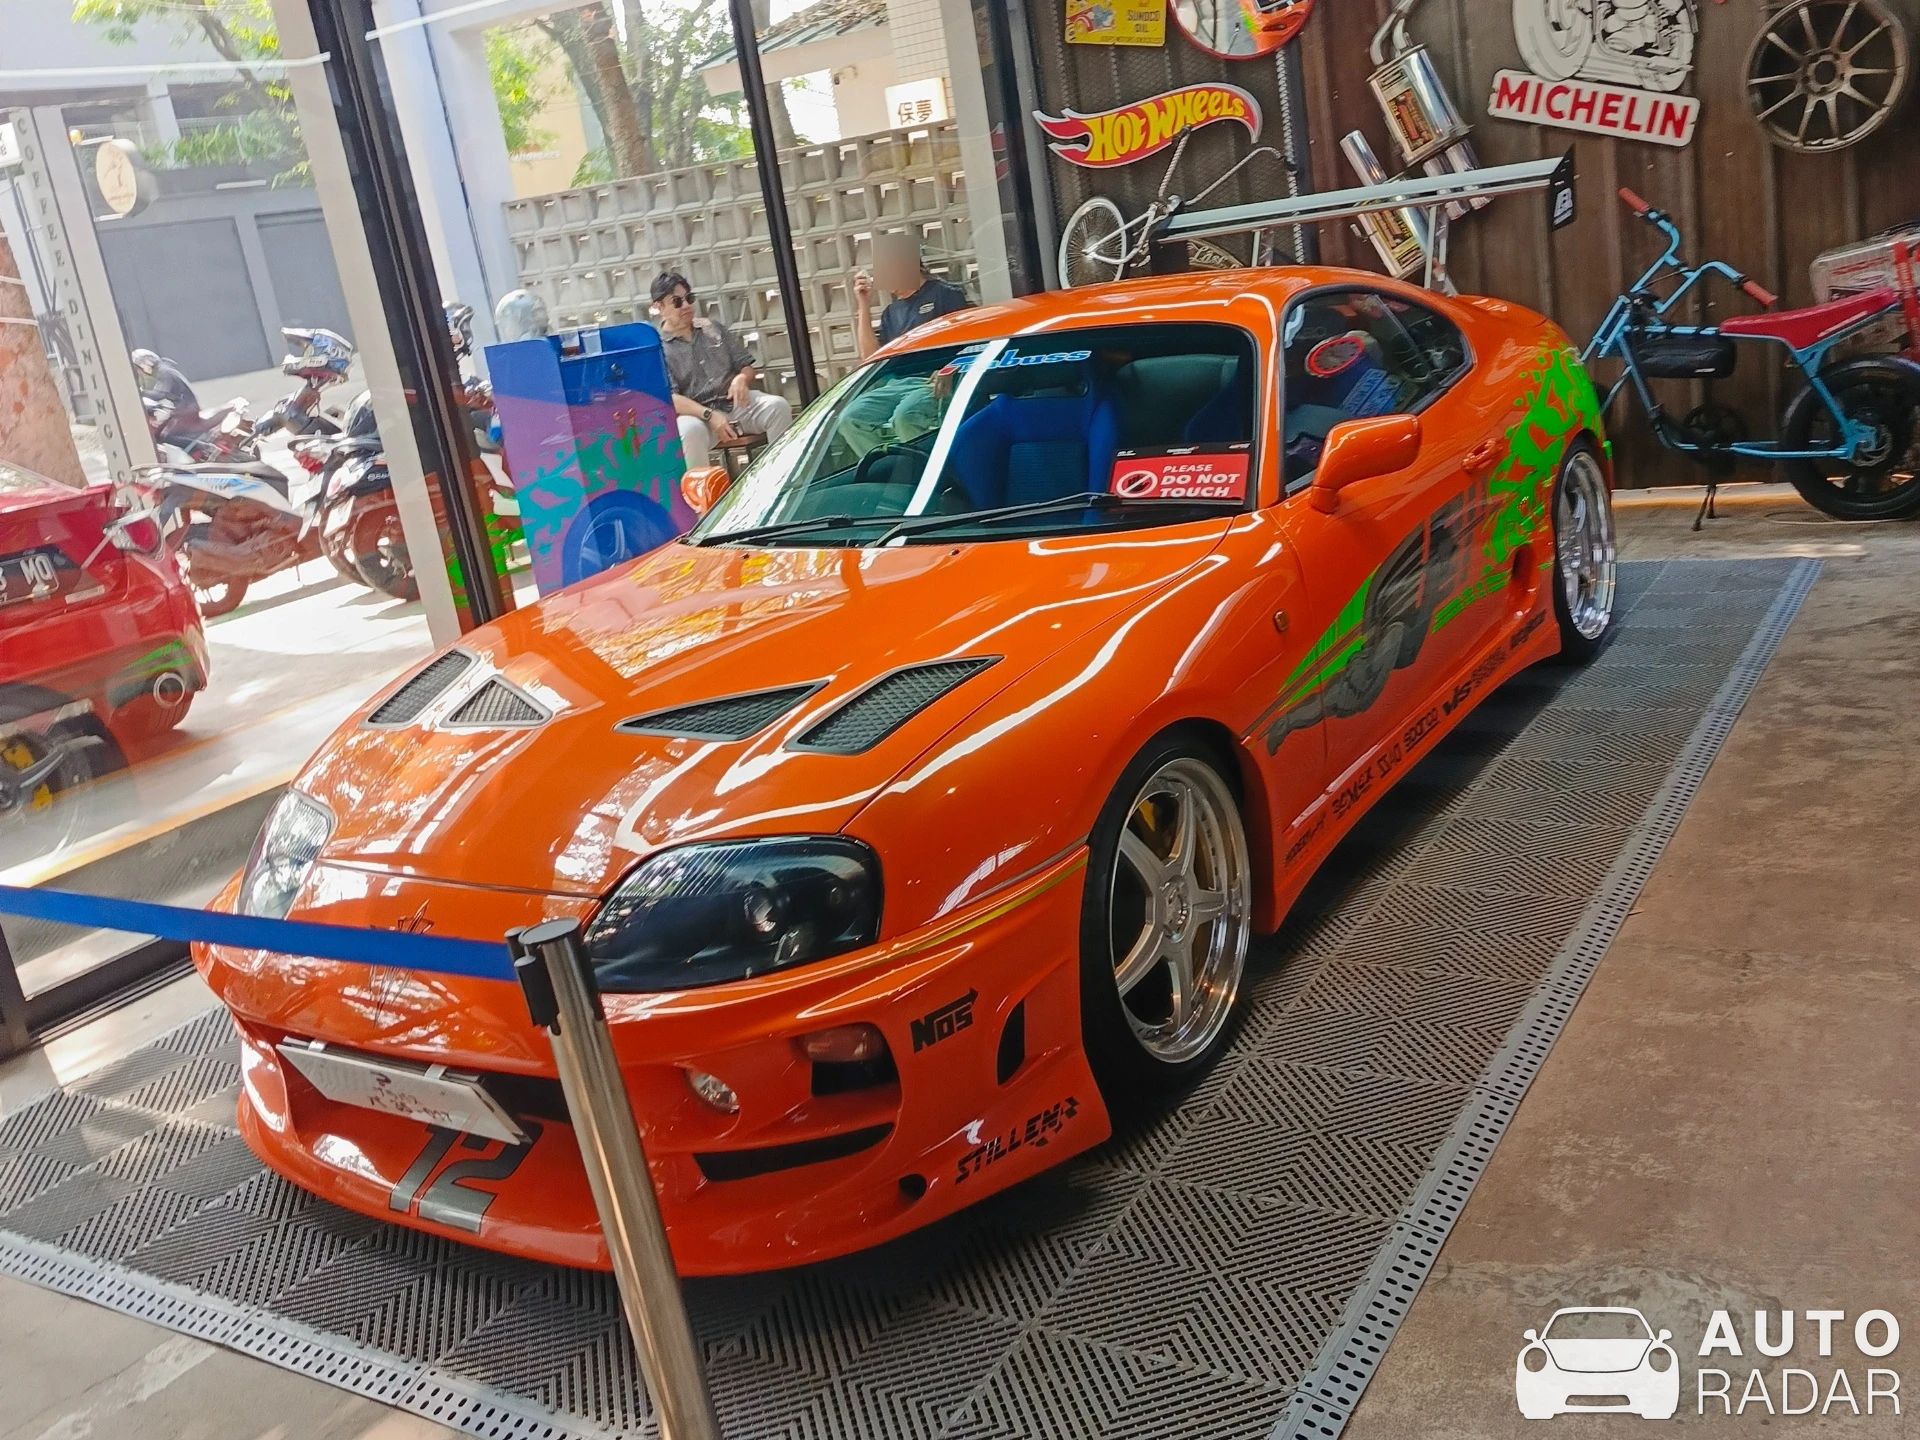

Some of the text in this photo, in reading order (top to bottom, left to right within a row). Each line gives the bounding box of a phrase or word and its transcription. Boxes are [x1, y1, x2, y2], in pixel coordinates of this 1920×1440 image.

[1081, 90, 1246, 161] HOT WHEELS
[1495, 76, 1691, 139] MICHELIN
[17, 117, 114, 440] COFFEE DINING
[1159, 486, 1231, 498] TOUCH
[1160, 473, 1241, 485] DO NOT
[1162, 463, 1214, 473] PLEASE
[909, 988, 978, 1054] NOS
[389, 1115, 544, 1235] 12
[955, 1103, 1061, 1185] STILLEN
